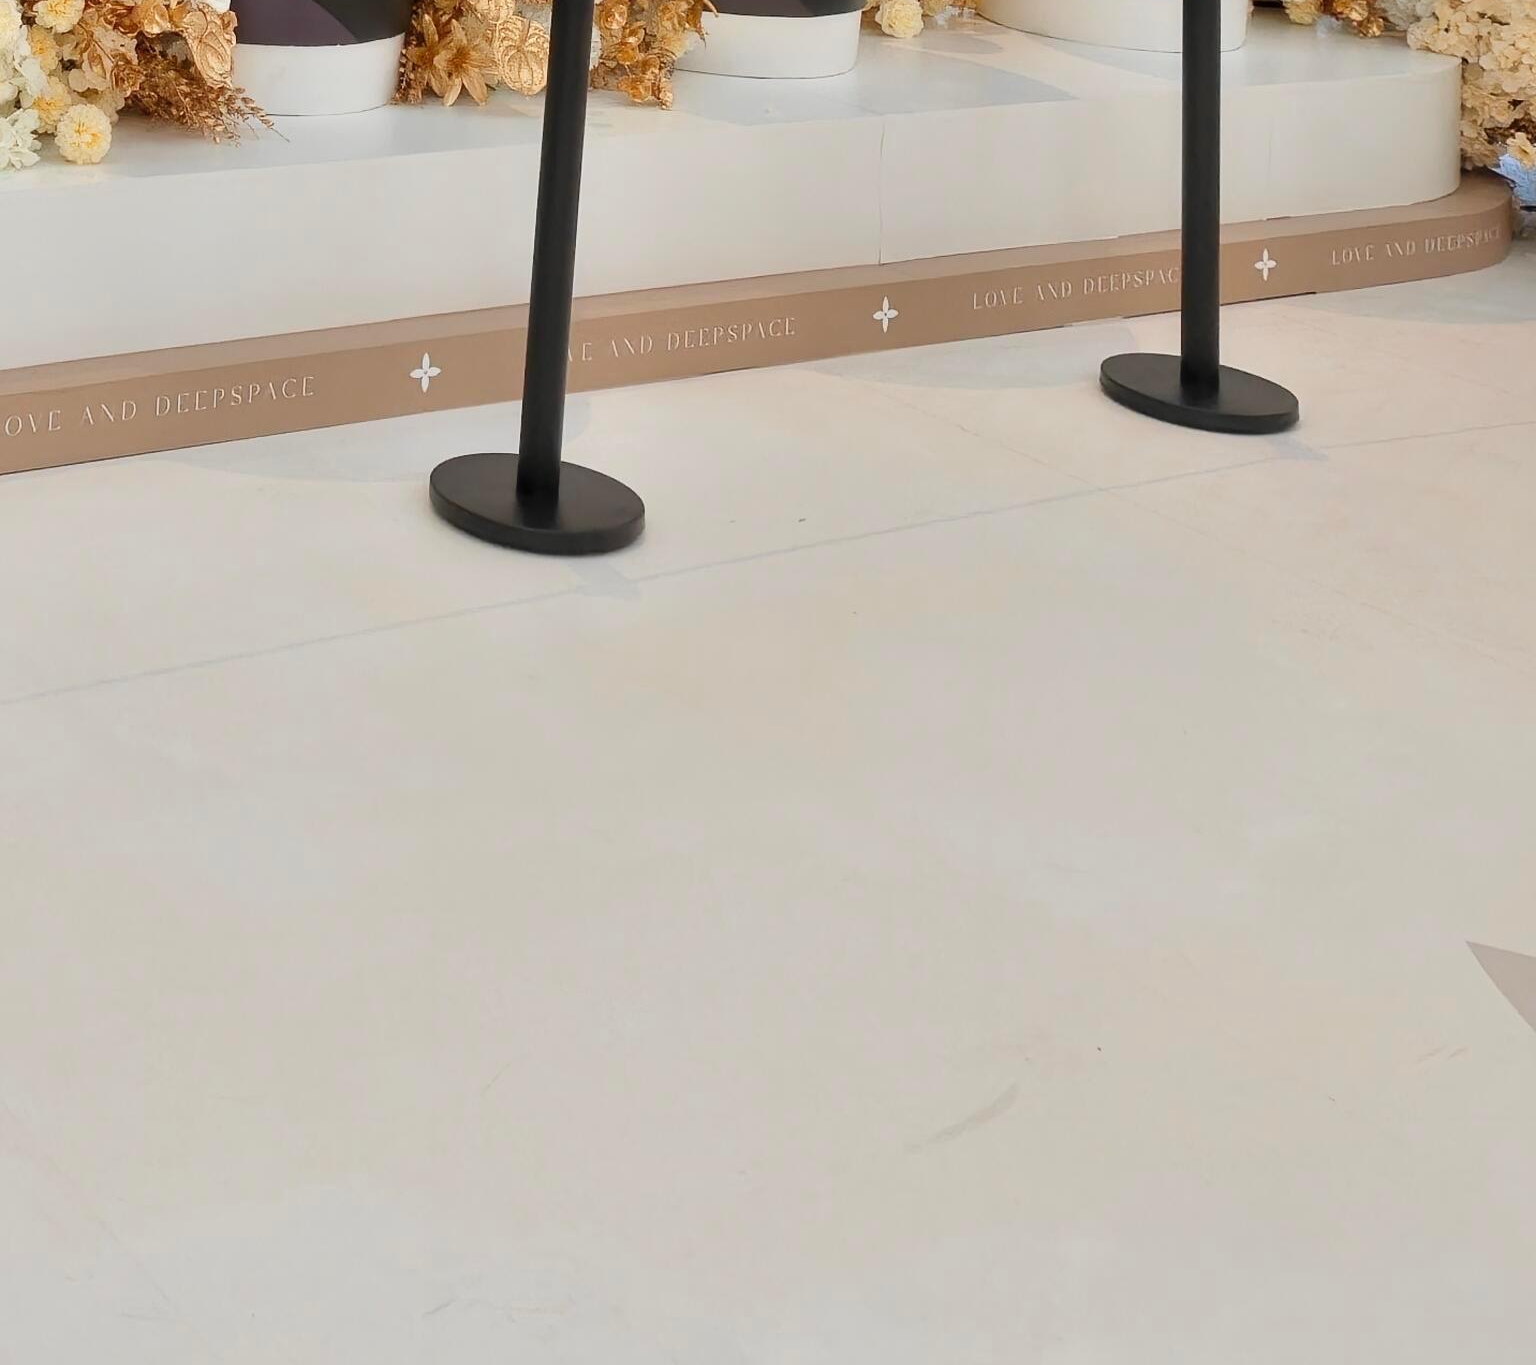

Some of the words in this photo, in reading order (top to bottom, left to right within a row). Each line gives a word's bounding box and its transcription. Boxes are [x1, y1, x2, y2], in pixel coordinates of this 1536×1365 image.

[1331, 243, 1375, 266] LOVE
[972, 286, 1024, 311] LOVE
[1037, 278, 1073, 302] AND
[1083, 266, 1180, 295] DEEPSPAC
[610, 334, 654, 359] AND
[666, 316, 797, 352] DEEPSPACE
[80, 400, 138, 427] AND
[154, 375, 317, 418] DEEPSPACE
